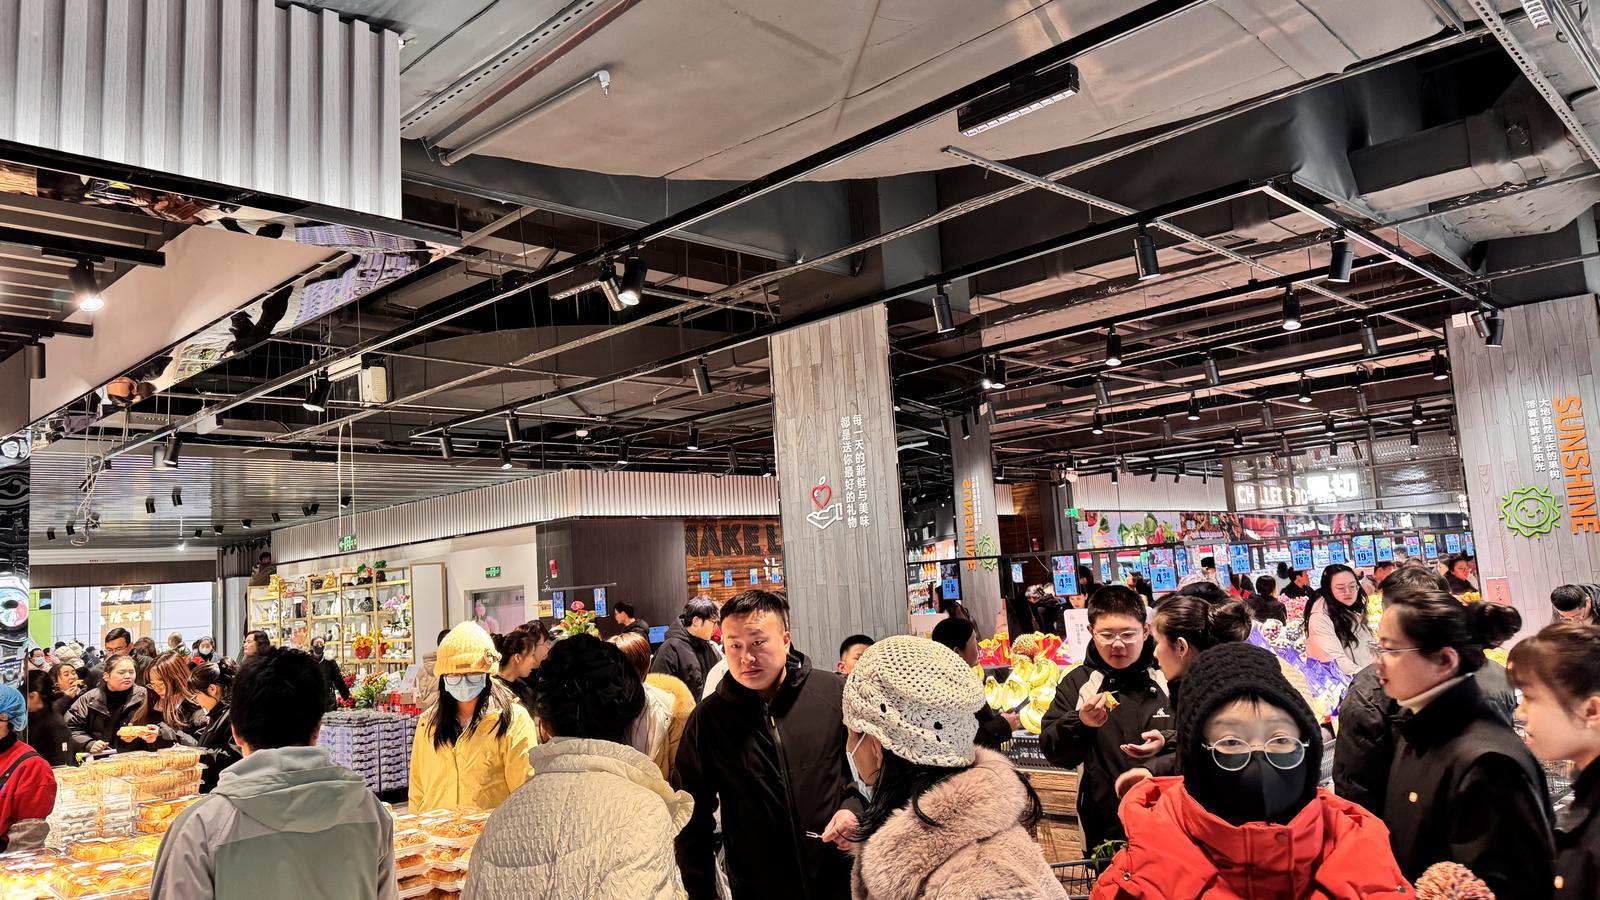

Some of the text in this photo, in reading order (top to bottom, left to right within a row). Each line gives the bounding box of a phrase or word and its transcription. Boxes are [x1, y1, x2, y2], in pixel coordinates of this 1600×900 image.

[840, 416, 858, 529] 都是送你最好的礼物
[852, 414, 870, 528] 每一天的新鲜与美味
[1526, 400, 1546, 472] 带着新鲜奔赴阳光
[1553, 395, 1600, 535] SUNSHINE
